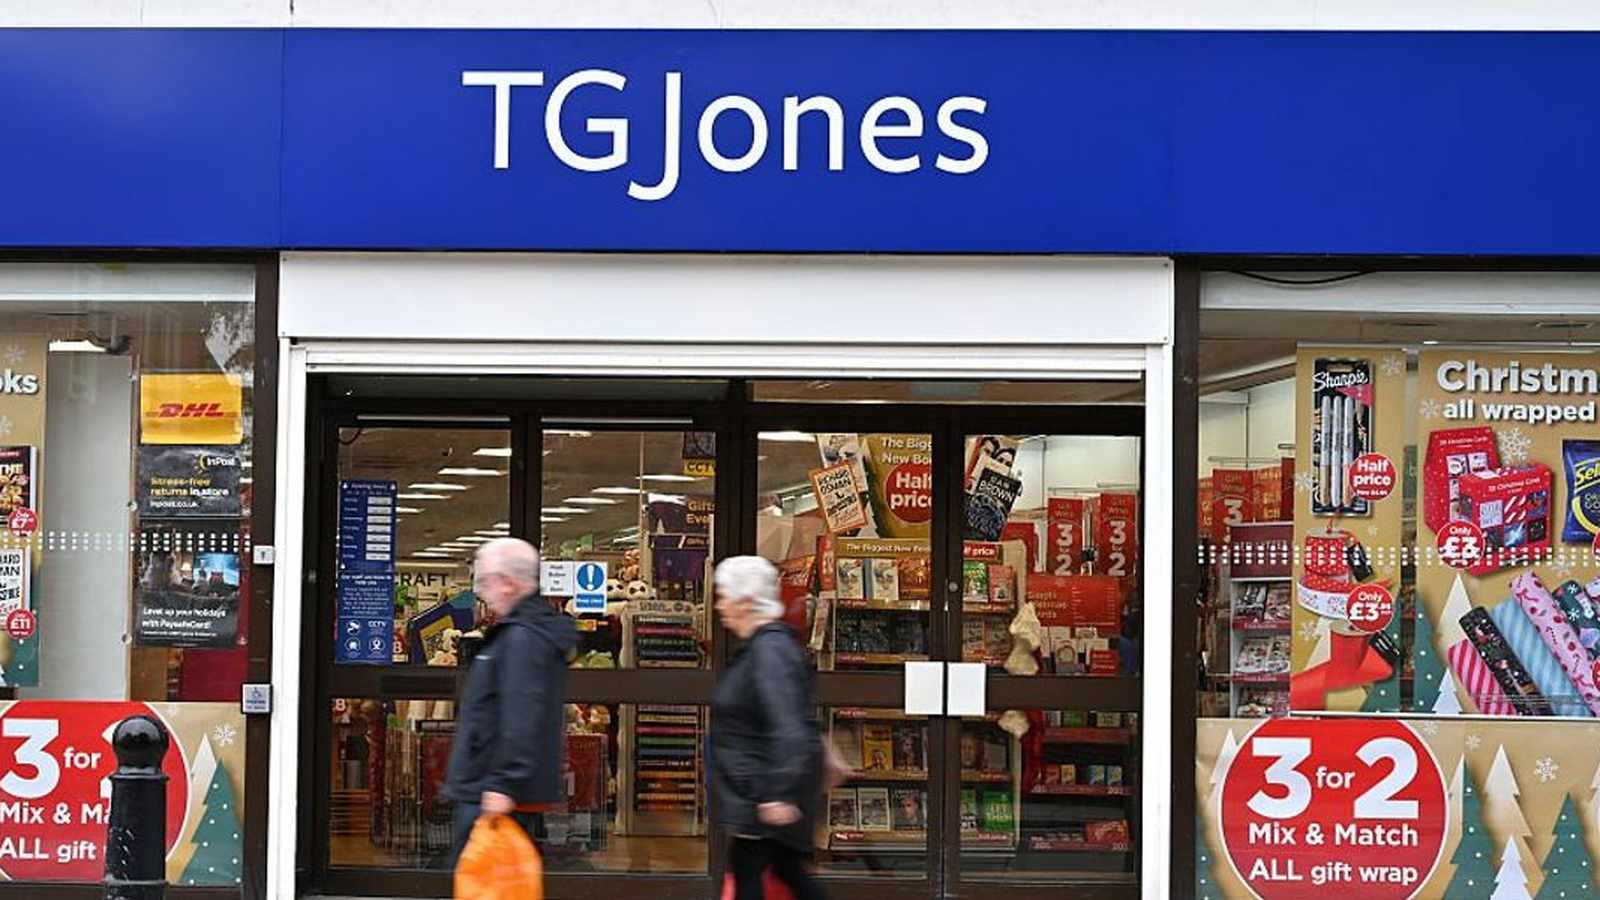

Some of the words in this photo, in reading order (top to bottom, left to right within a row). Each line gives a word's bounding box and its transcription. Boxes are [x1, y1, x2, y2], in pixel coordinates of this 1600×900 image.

[0, 368, 39, 393] ks
[1312, 370, 1369, 392] Sharpie
[1437, 360, 1599, 393] Christm
[159, 403, 224, 417] DHL
[1444, 399, 1474, 419] all
[1482, 400, 1594, 424] wrapped
[1357, 459, 1389, 472] Half
[1353, 472, 1392, 487] price
[1056, 524, 1073, 546] 3
[1109, 520, 1126, 545] 3
[1054, 554, 1073, 576] 2
[1108, 551, 1126, 576] 2
[0, 718, 61, 799] 3
[63, 746, 102, 769] for
[1246, 737, 1313, 819] 3
[1316, 766, 1356, 789] for
[1353, 737, 1419, 819] 2
[0, 801, 45, 825] Mix
[52, 802, 72, 824] &
[1248, 821, 1297, 845] Mix
[1304, 822, 1325, 845] &
[1334, 823, 1419, 847] Match
[0, 837, 50, 859] ALL
[57, 841, 97, 864] gift
[1248, 858, 1303, 881] ALL
[1310, 861, 1353, 886] gift
[1358, 866, 1419, 886] wrap
